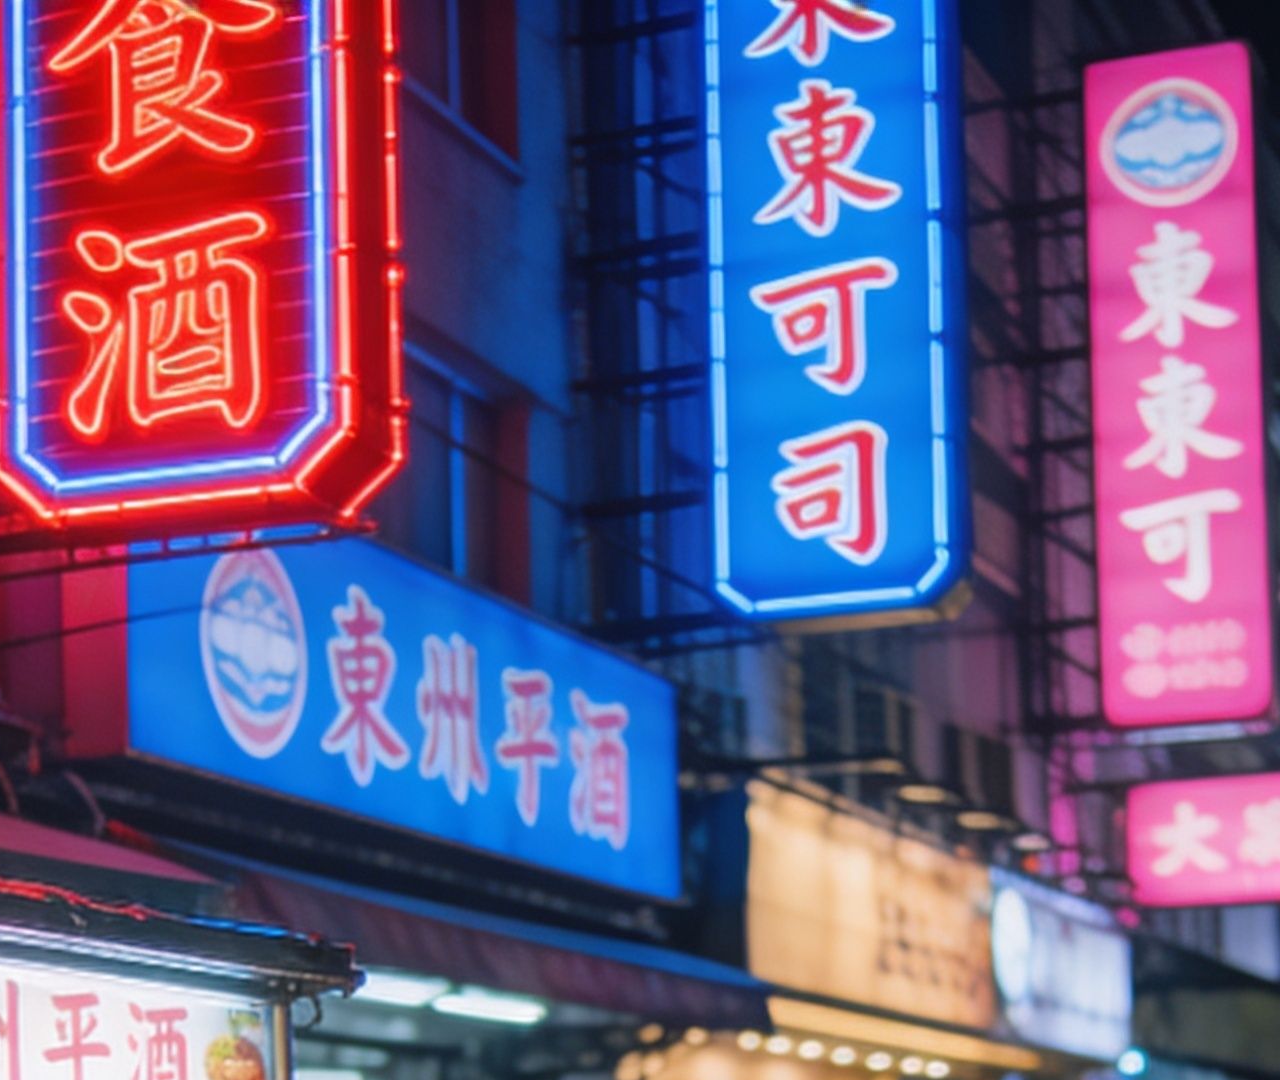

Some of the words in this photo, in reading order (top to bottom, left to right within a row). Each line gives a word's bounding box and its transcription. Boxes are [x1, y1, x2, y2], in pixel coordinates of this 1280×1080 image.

[1118, 221, 1245, 603] 東東可
[320, 583, 630, 851] 東州平酒
